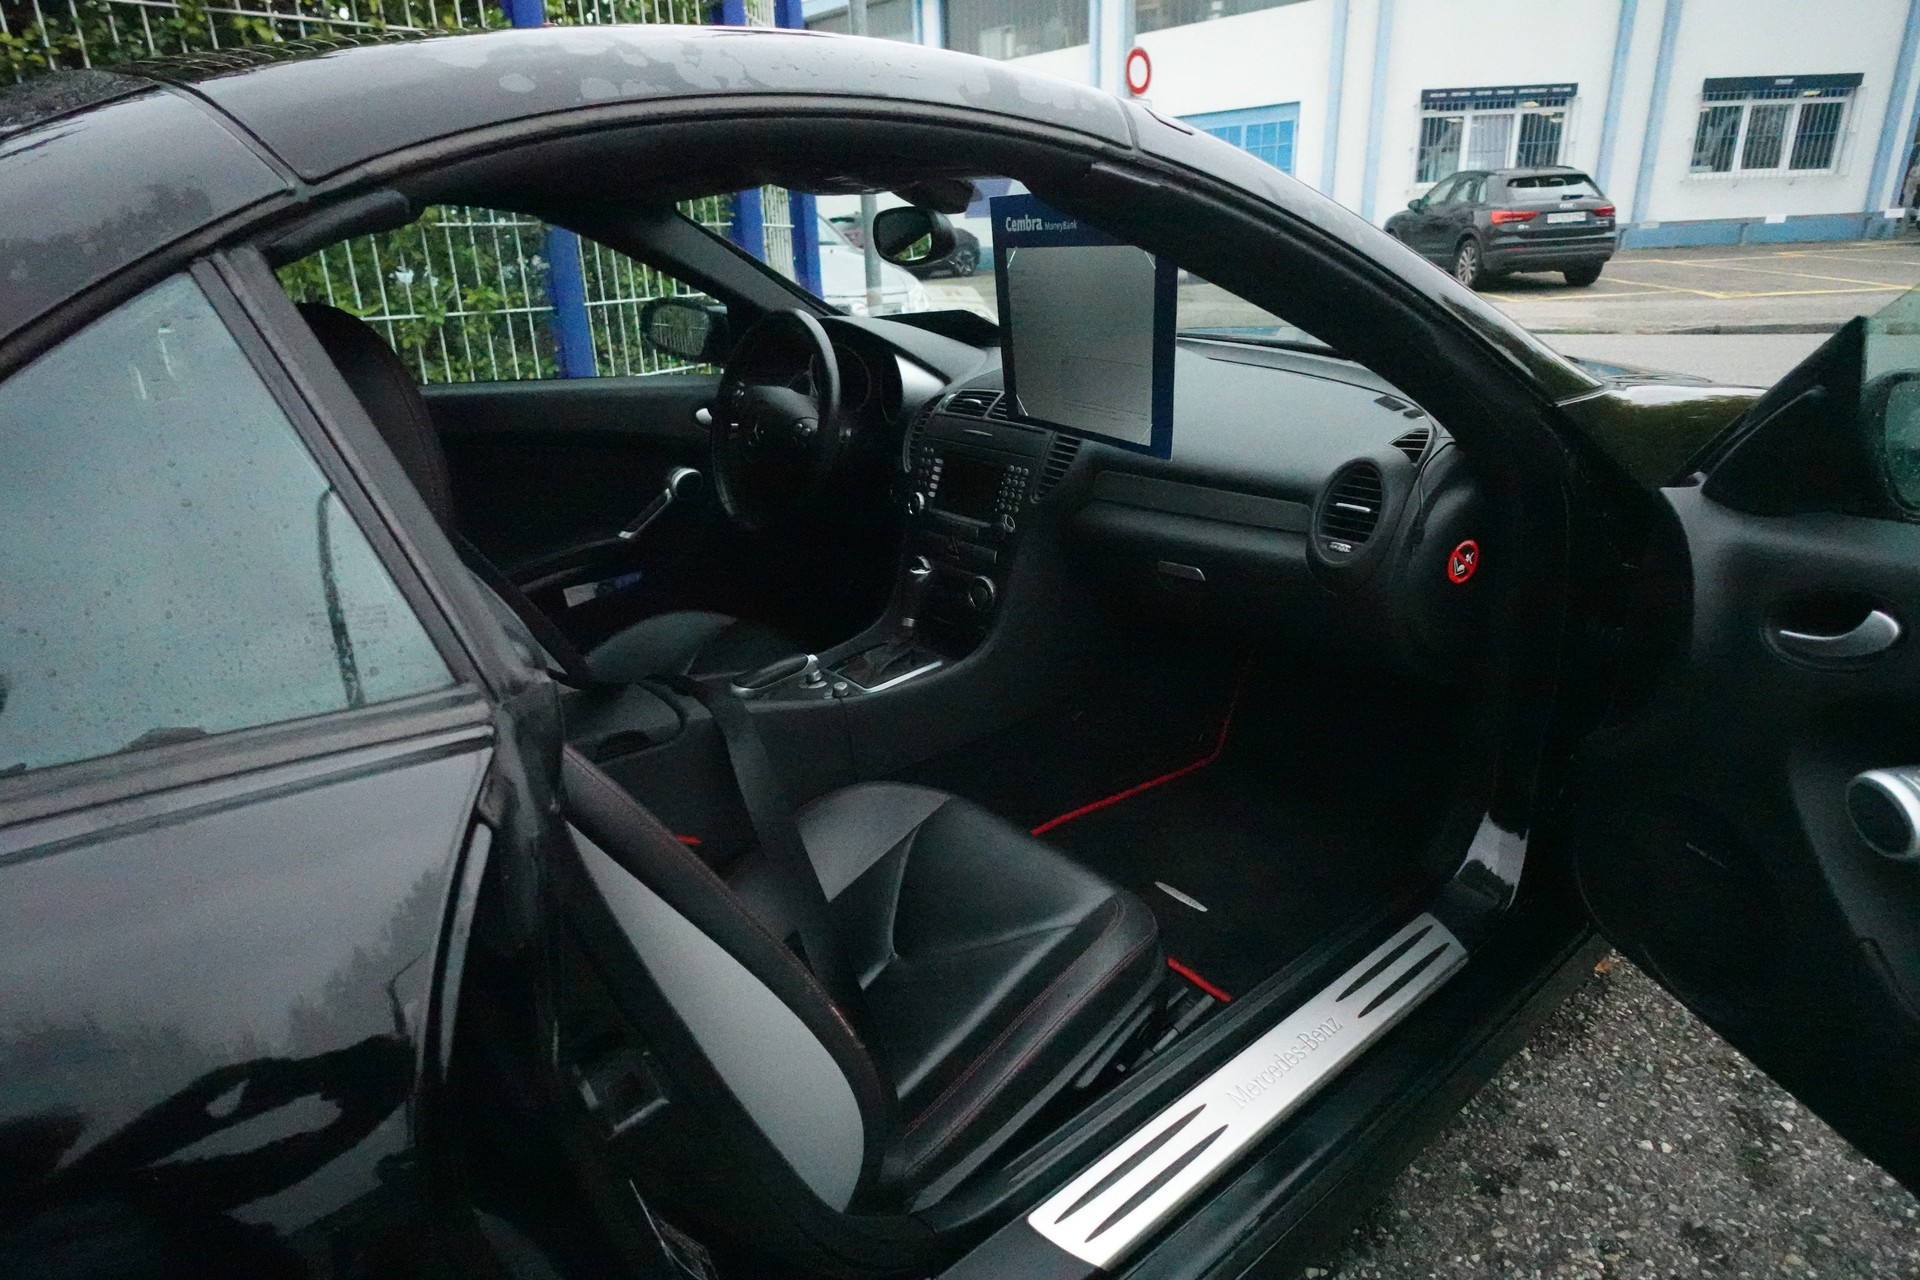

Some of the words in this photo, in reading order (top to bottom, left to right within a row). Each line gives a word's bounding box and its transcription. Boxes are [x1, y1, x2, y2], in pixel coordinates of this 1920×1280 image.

[1005, 214, 1043, 232] Cembra
[1044, 219, 1078, 232] MoneyBank
[1227, 1016, 1343, 1110] Mercedes-Benz
